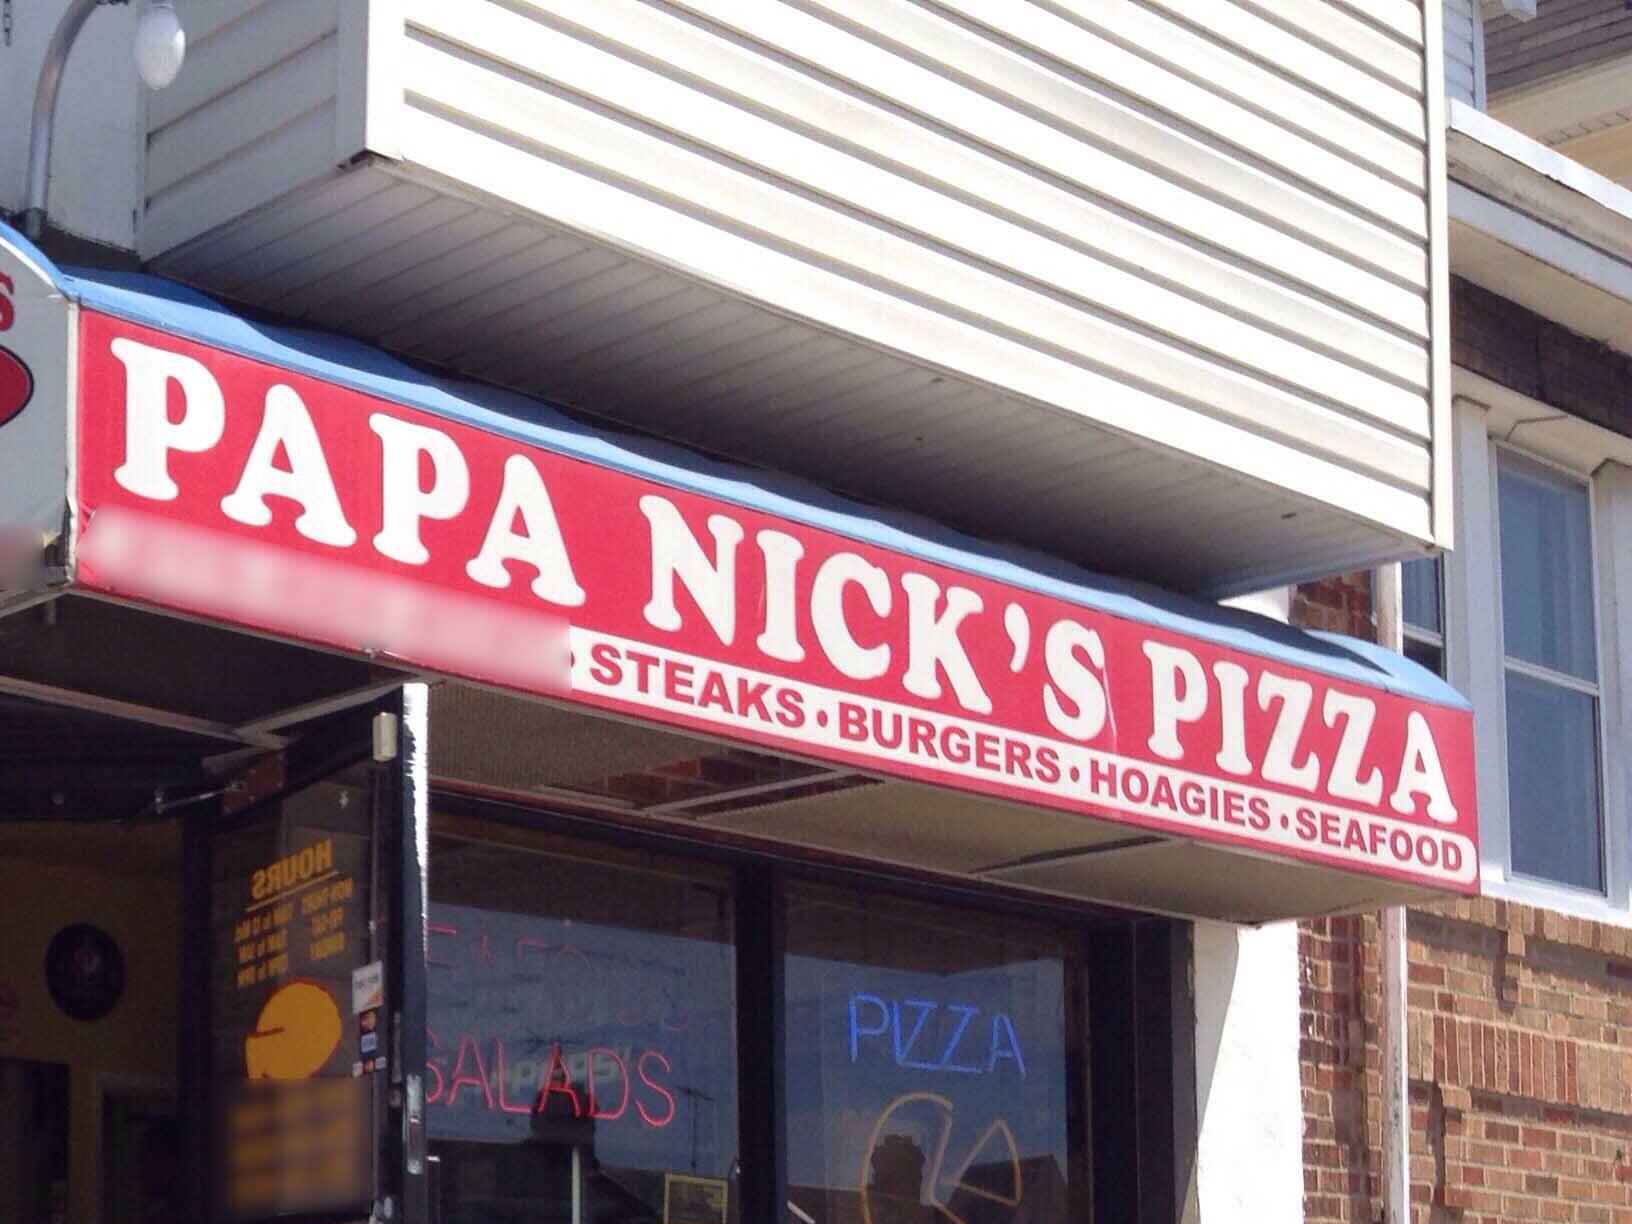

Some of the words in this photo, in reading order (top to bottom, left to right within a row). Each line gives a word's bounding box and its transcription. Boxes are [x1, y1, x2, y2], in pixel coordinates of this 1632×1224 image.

[111, 336, 585, 607] PAPA
[638, 494, 1109, 741] NICK'S
[1142, 637, 1459, 824] PIZZA
[589, 644, 807, 729] STEAKS
[838, 702, 1060, 784] BURGERS
[1089, 760, 1271, 833] HOAGIES
[1296, 809, 1464, 872] SEAFOOD
[848, 992, 1026, 1080] PIZZA
